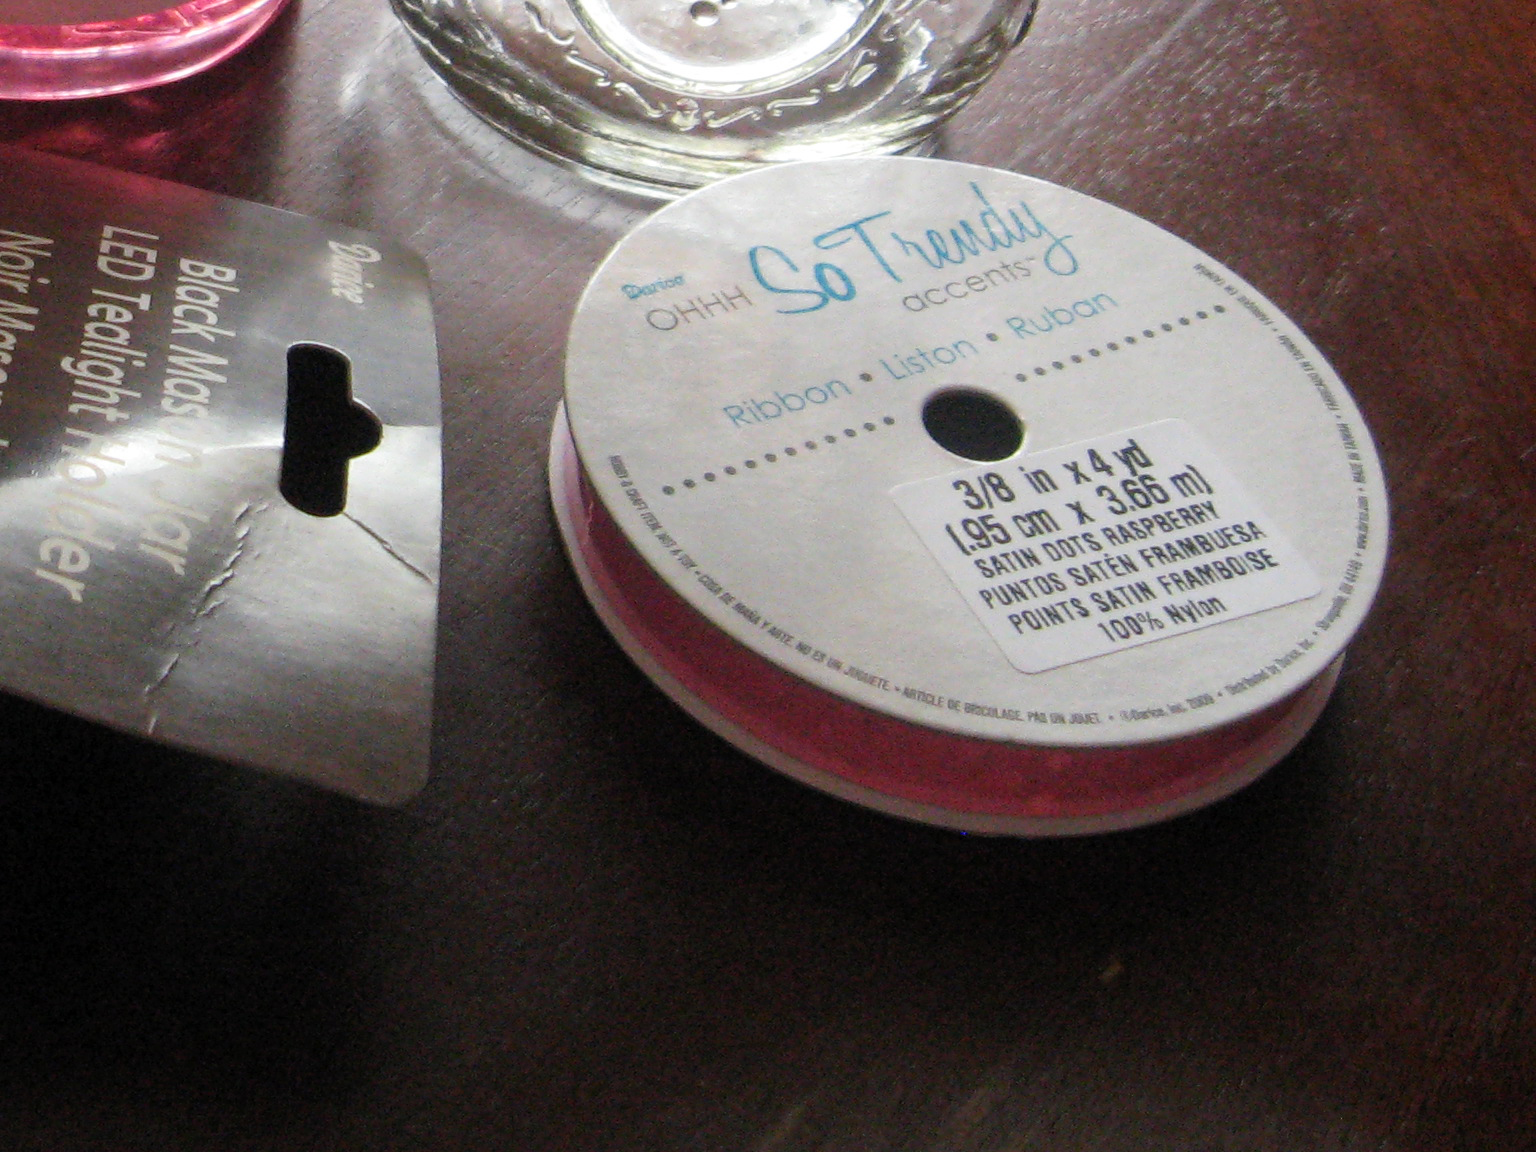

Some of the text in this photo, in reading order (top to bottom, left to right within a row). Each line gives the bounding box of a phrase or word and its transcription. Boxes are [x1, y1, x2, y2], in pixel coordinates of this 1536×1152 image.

[328, 240, 382, 304] Darice
[621, 275, 686, 301] Darice
[748, 181, 1080, 316] So Trendy
[645, 258, 1032, 333] OHHH accents
[722, 290, 1119, 428] Ribbon Liston Ruban
[34, 224, 159, 604] LED Tealight Holder
[139, 257, 240, 576] Black Mason Jar
[952, 438, 1154, 512] 3/8 in x 4 yd
[1012, 507, 1061, 539] cm
[1066, 501, 1095, 526] x
[1097, 474, 1171, 516] 3.66
[1172, 464, 1214, 499] m)
[974, 500, 1222, 579] SATIN DOTS RASPBERRY
[978, 572, 1064, 610] PUNTOS
[1141, 521, 1267, 569] FRAMBUESA
[1007, 548, 1280, 635] POINTS SATIN FRAMBOISE
[1097, 595, 1227, 643] 100% Nylon
